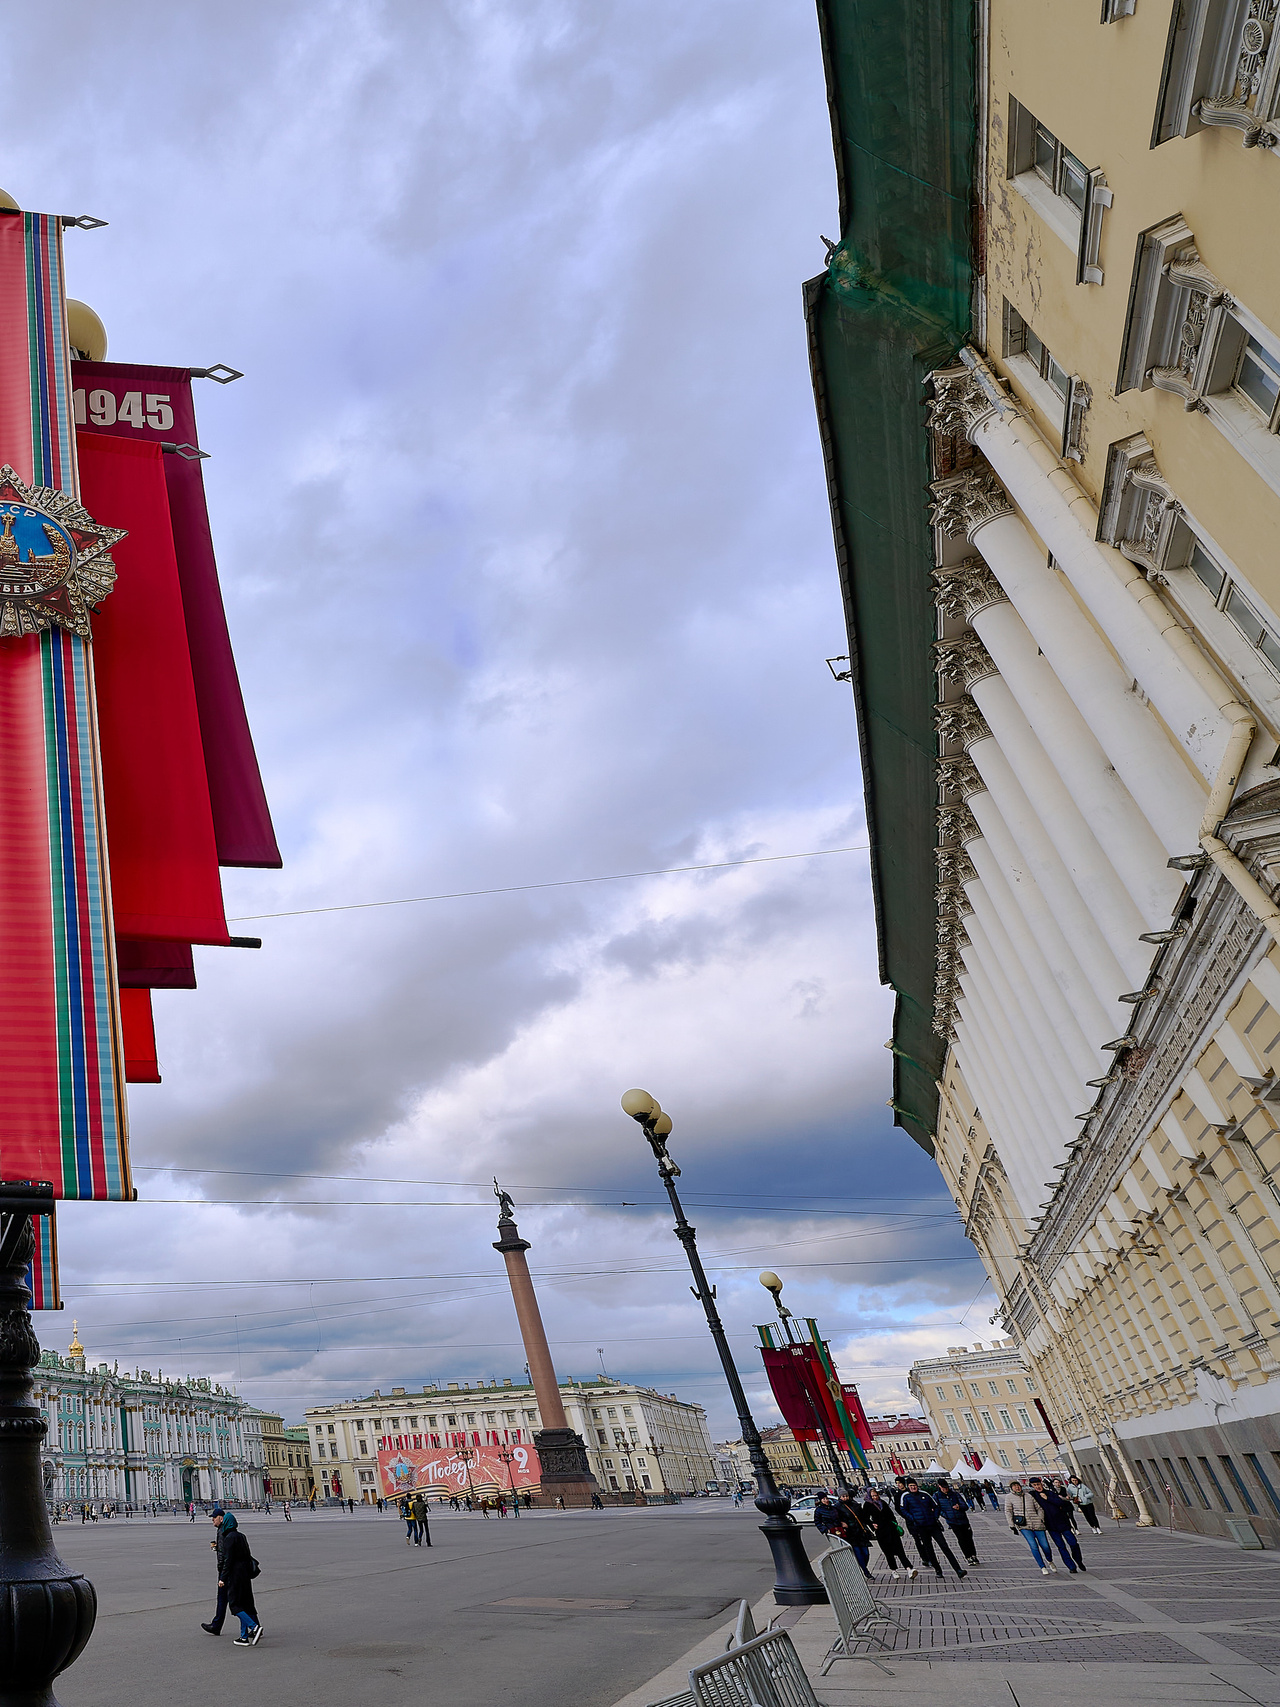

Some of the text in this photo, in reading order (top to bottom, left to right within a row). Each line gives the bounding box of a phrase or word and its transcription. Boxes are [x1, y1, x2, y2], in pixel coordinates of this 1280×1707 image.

[73, 388, 175, 430] 1945
[791, 1347, 804, 1356] 1941
[420, 1448, 480, 1486] Победа!
[513, 1447, 529, 1469] 9
